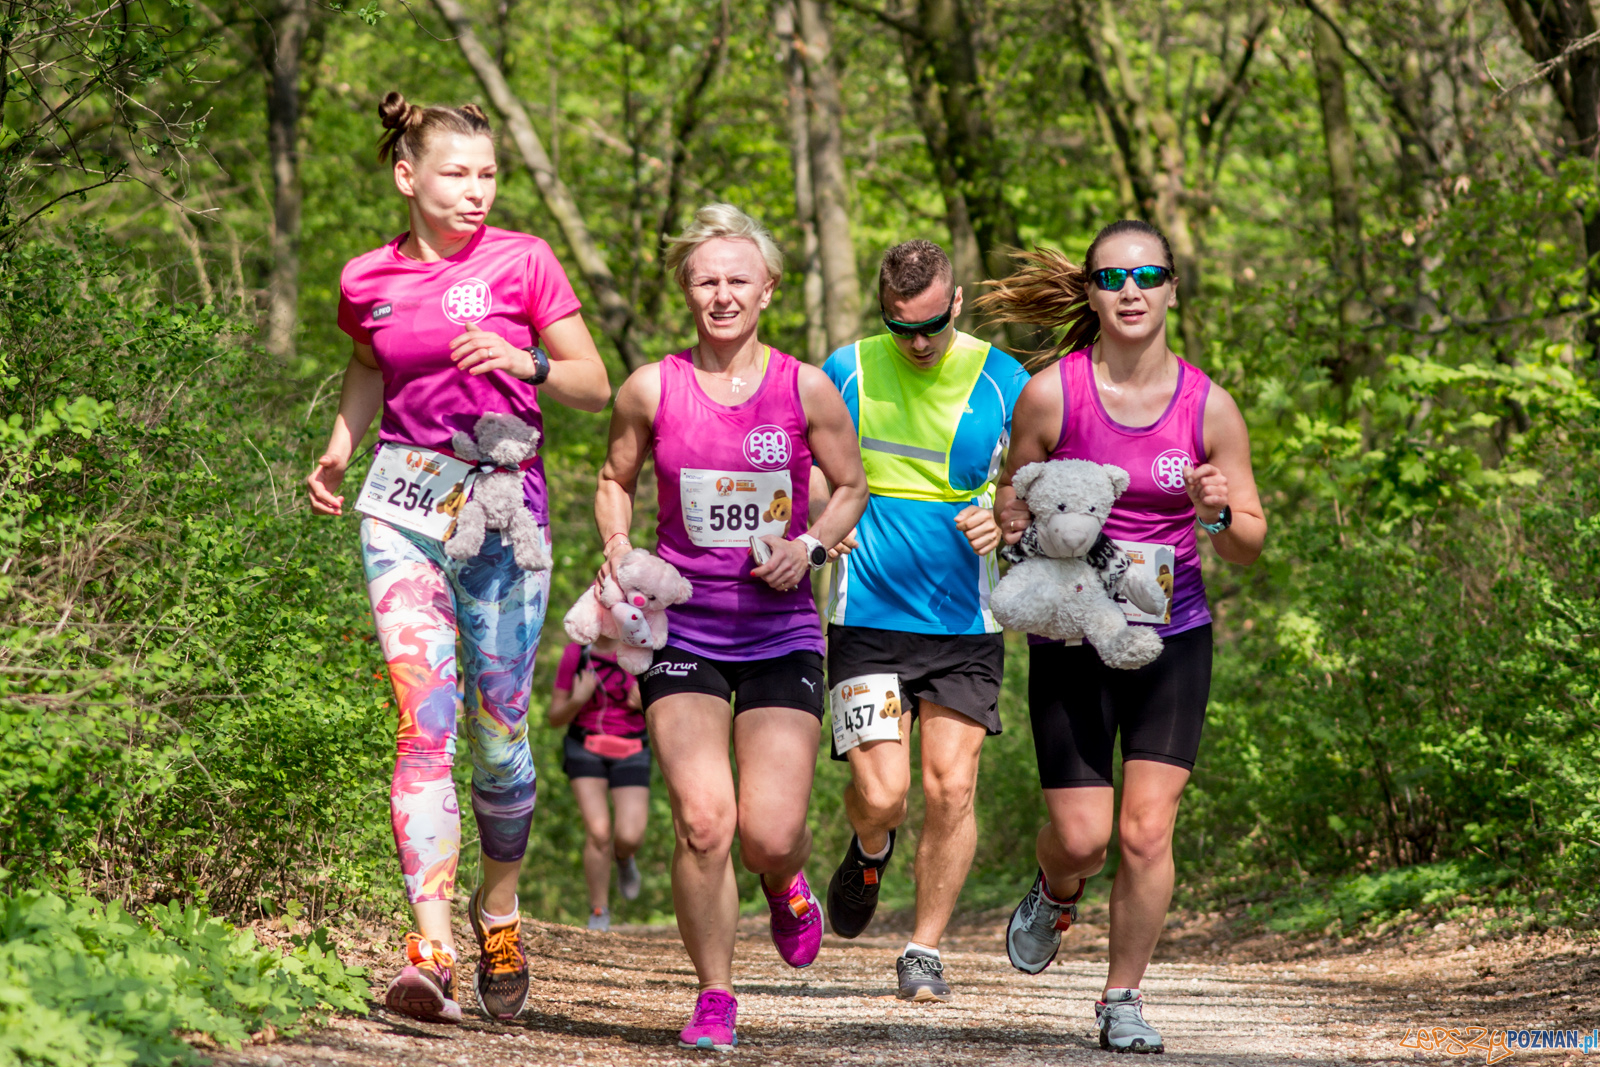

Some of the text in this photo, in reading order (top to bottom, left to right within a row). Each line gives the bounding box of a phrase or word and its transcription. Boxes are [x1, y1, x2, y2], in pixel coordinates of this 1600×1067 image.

[387, 477, 435, 517] 254
[709, 503, 760, 531] 589
[673, 662, 698, 670] run
[844, 703, 875, 733] 437
